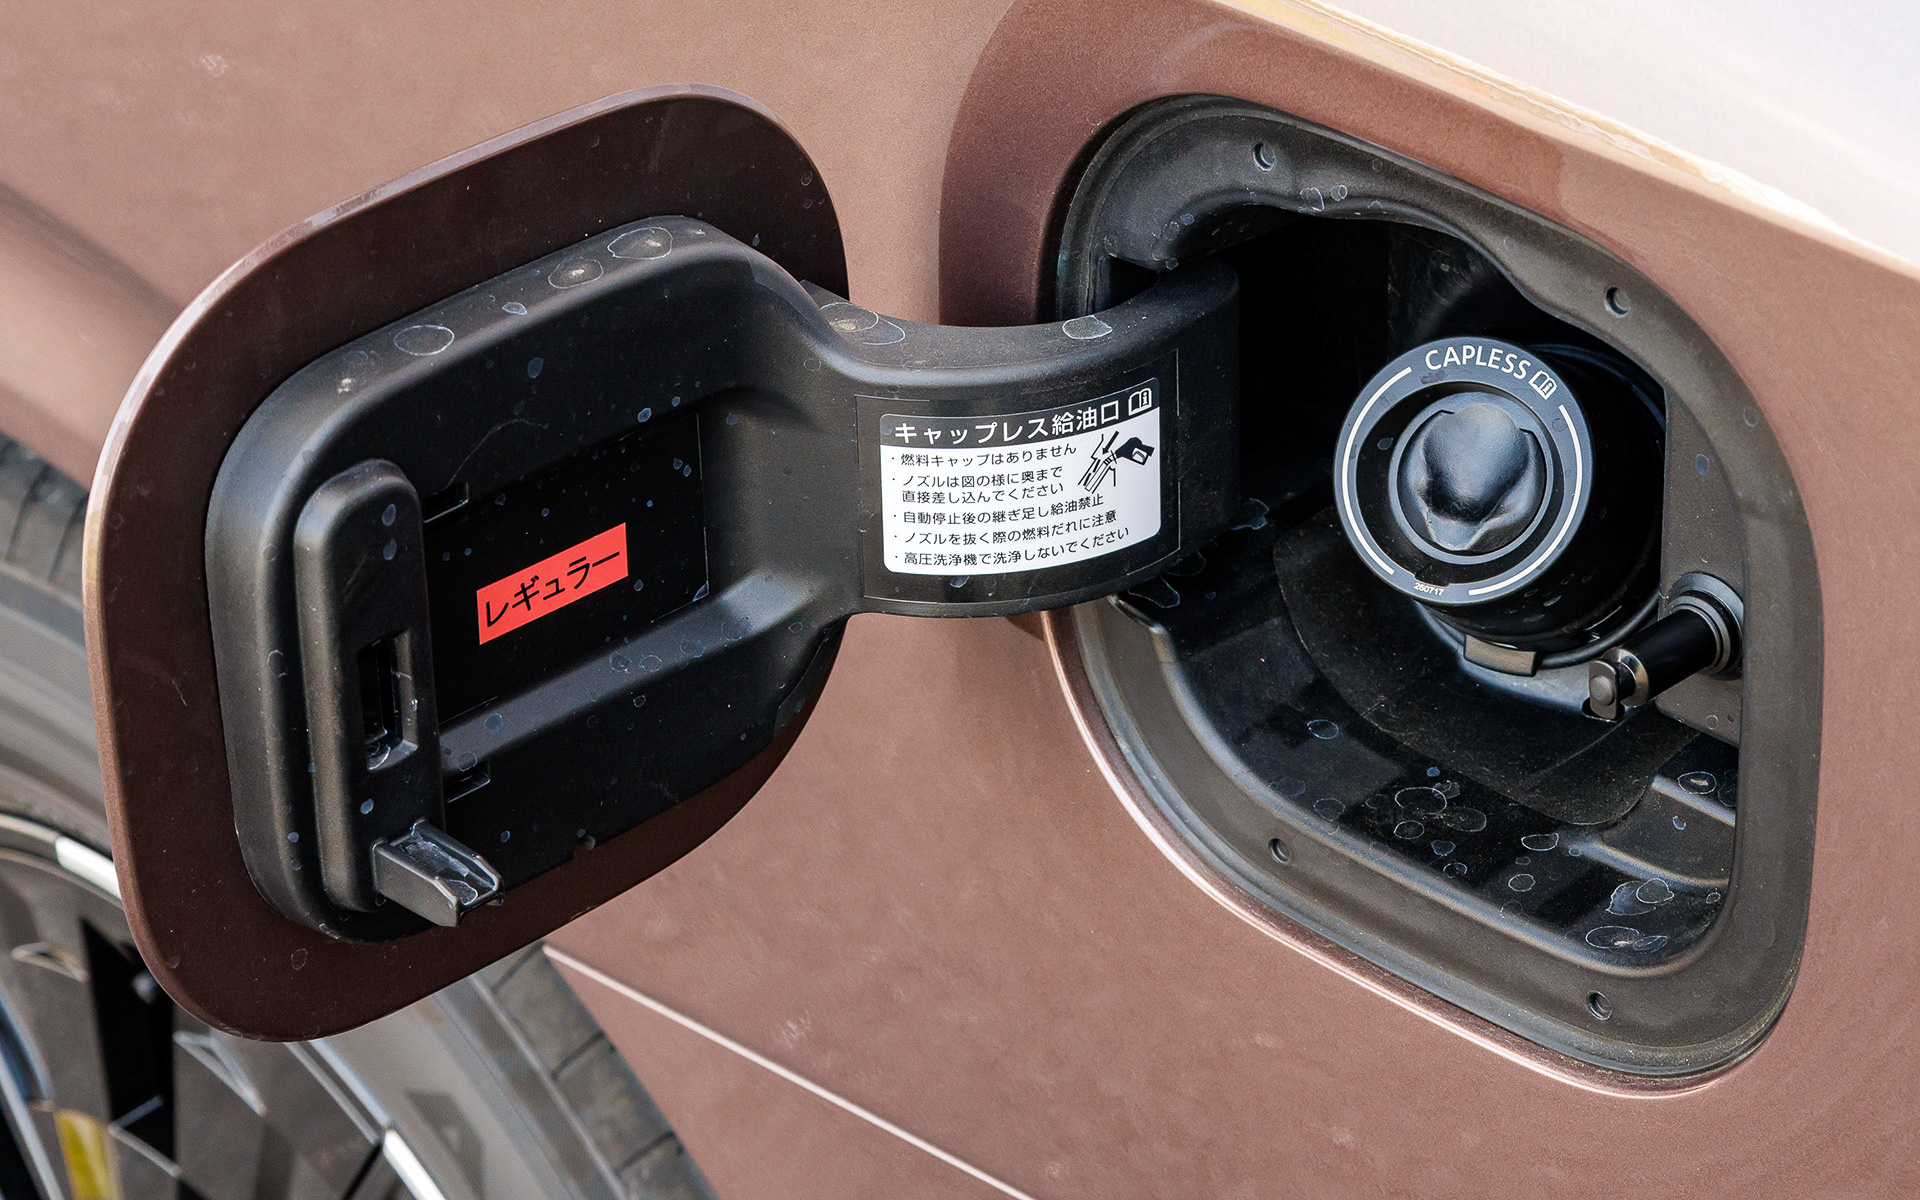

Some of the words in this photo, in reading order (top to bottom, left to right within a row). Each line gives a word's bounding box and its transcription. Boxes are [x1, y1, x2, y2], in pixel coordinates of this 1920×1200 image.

[1425, 345, 1531, 380] CAPLESS
[894, 401, 1120, 444] キャップレス給油口
[902, 482, 1064, 504] 直接差し込んでください
[486, 551, 620, 627] レギュラー
